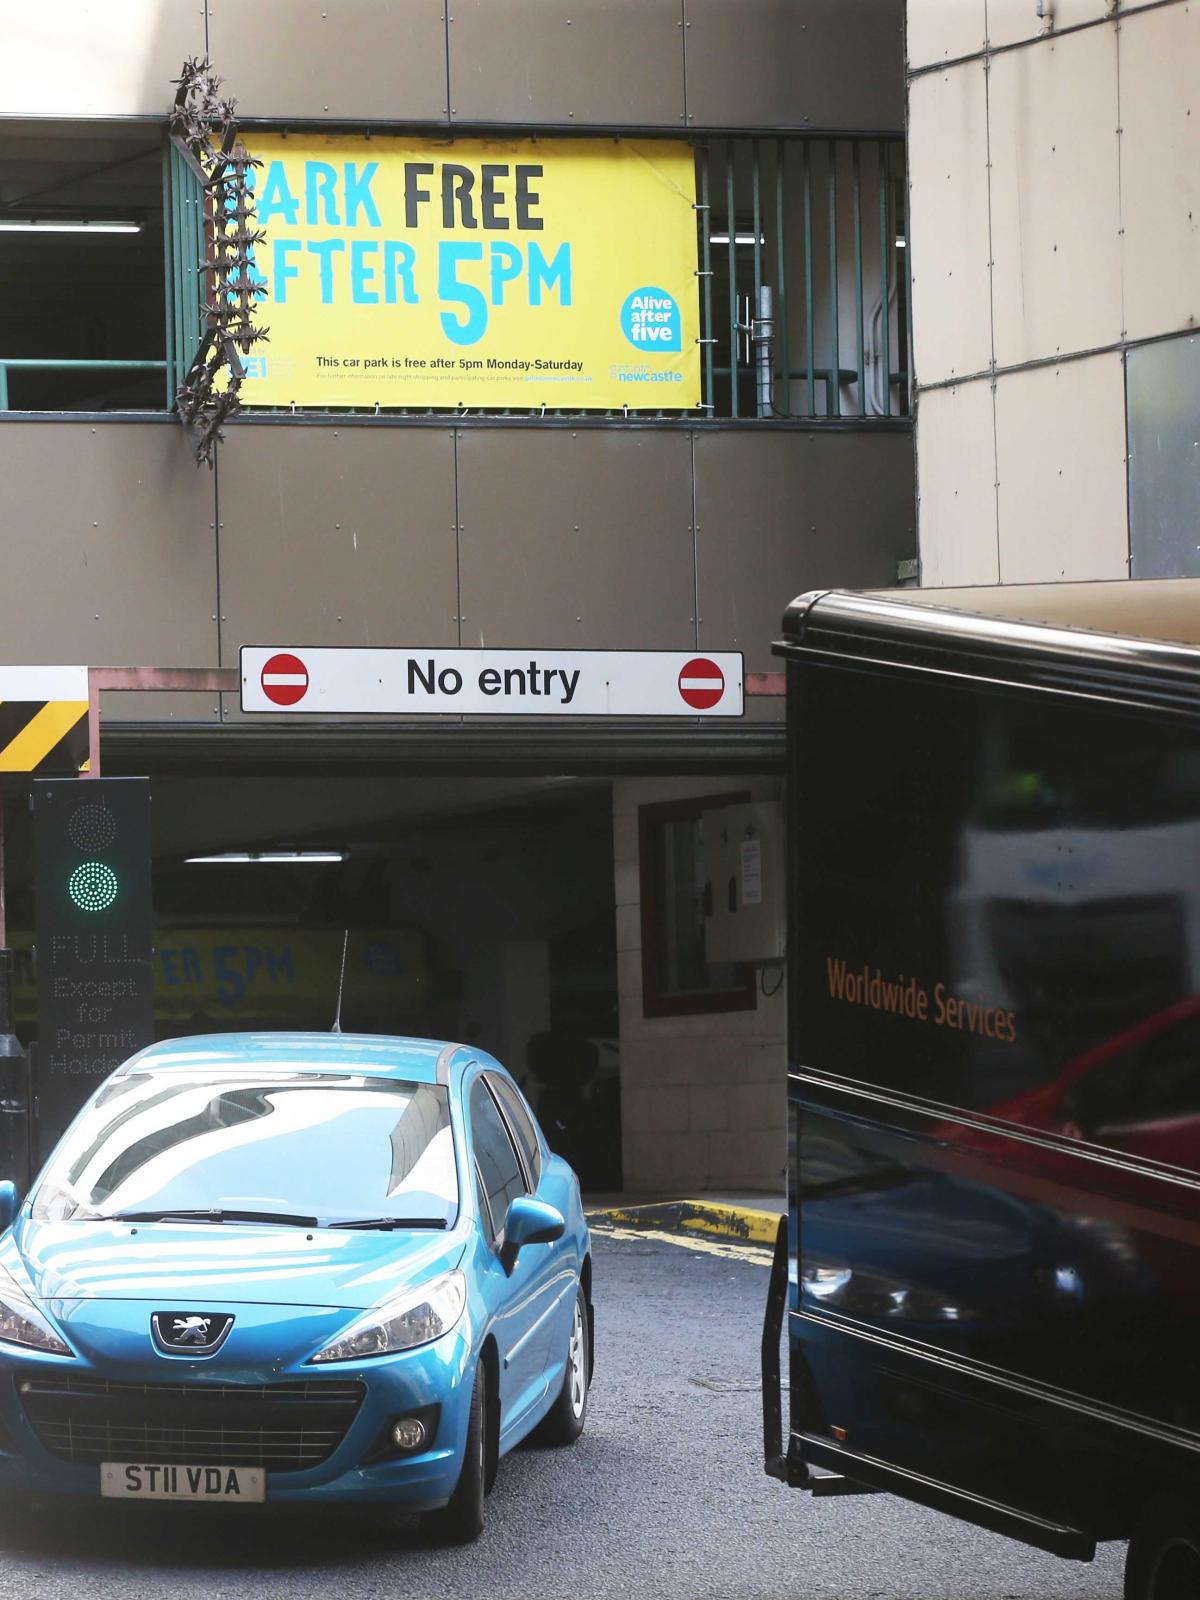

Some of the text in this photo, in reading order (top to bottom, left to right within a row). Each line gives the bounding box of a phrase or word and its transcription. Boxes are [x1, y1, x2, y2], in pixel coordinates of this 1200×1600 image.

[404, 163, 543, 230] FREE
[437, 240, 572, 346] 5PM
[631, 296, 672, 309] Alive
[631, 310, 672, 322] after
[631, 323, 672, 341] five
[316, 357, 339, 367] This
[343, 359, 360, 367] car
[364, 358, 388, 369] park
[392, 358, 401, 367] is
[404, 358, 426, 368] free
[430, 358, 455, 368] after
[459, 359, 483, 370] 5pm
[486, 359, 583, 371] Monday-Saturday
[618, 371, 682, 382] newcastle
[407, 659, 580, 704] No entry
[52, 935, 141, 964] FULL
[54, 977, 139, 1000] Except
[827, 956, 1016, 1042] Worldwide Services
[76, 1002, 112, 1022] for
[56, 1028, 137, 1049] Permit
[50, 1054, 120, 1074] Holde
[186, 1467, 240, 1495] VDA
